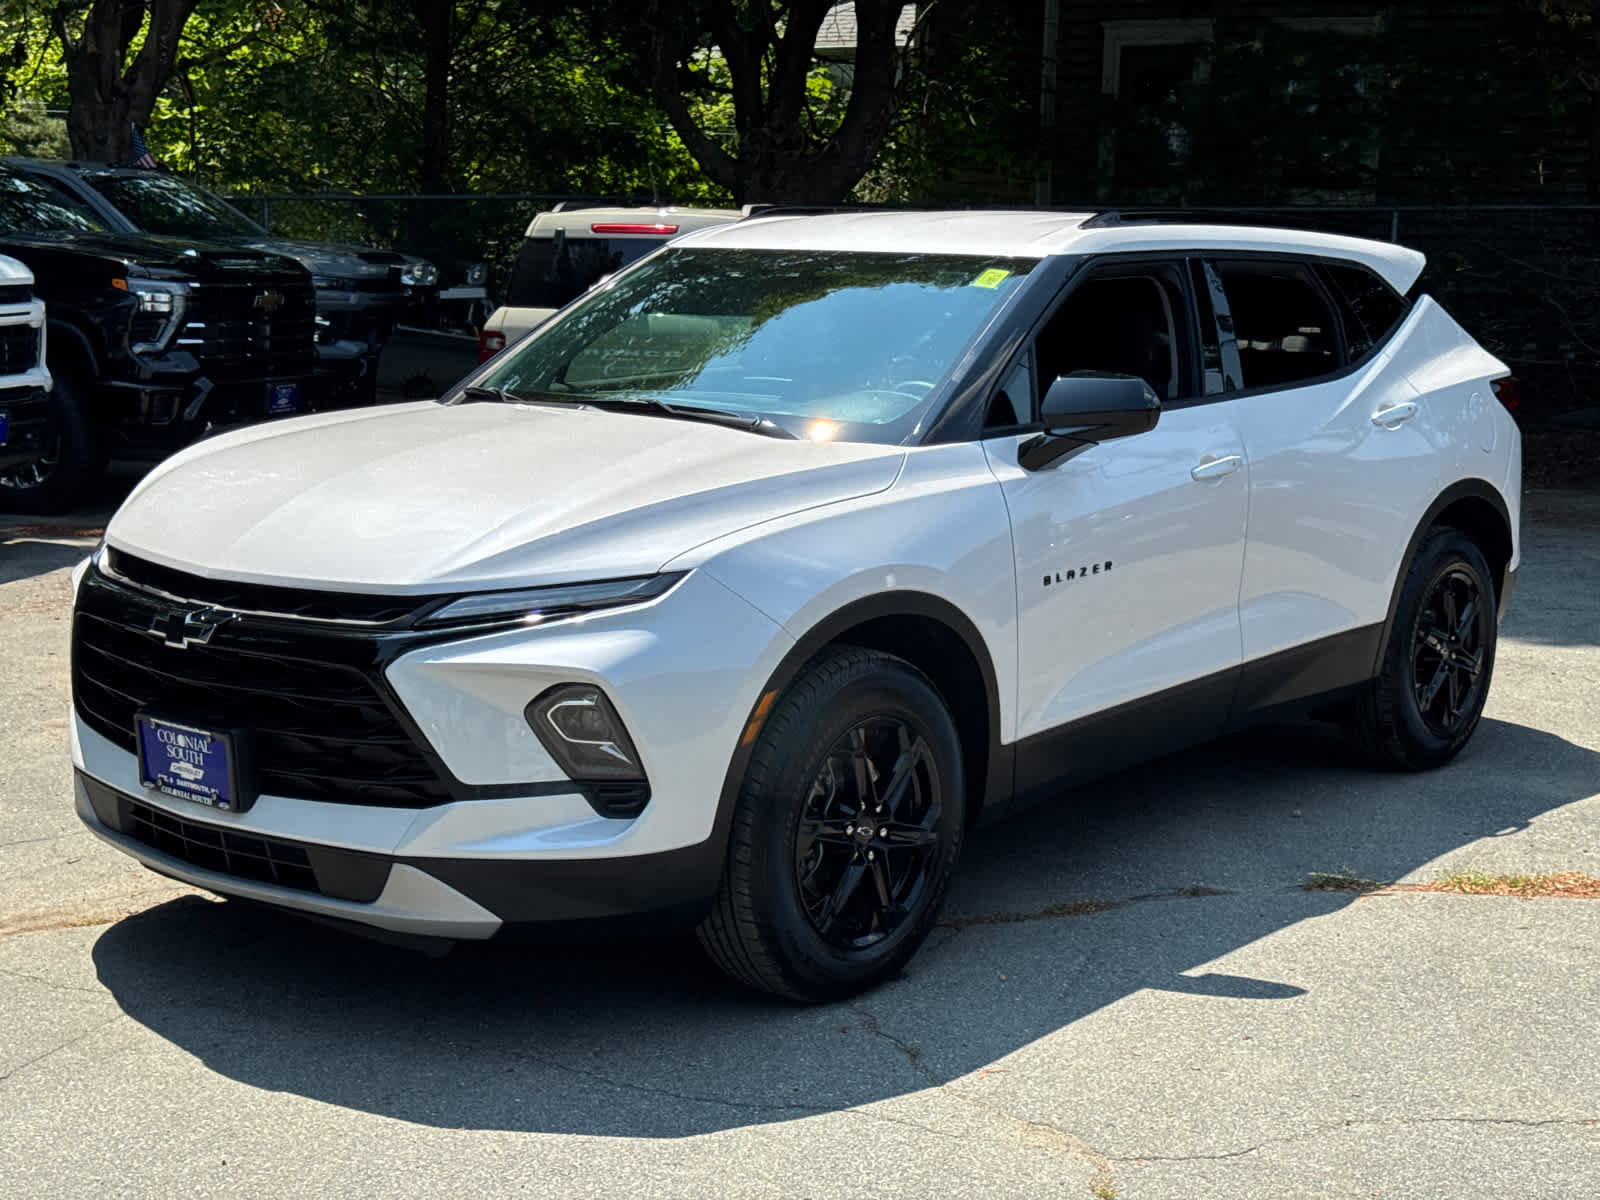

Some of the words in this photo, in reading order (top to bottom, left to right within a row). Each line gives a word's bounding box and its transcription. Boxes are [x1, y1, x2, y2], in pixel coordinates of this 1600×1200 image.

[1043, 560, 1113, 586] BLAZER
[157, 728, 213, 754] COLONIAL
[166, 745, 204, 765] SOUTH
